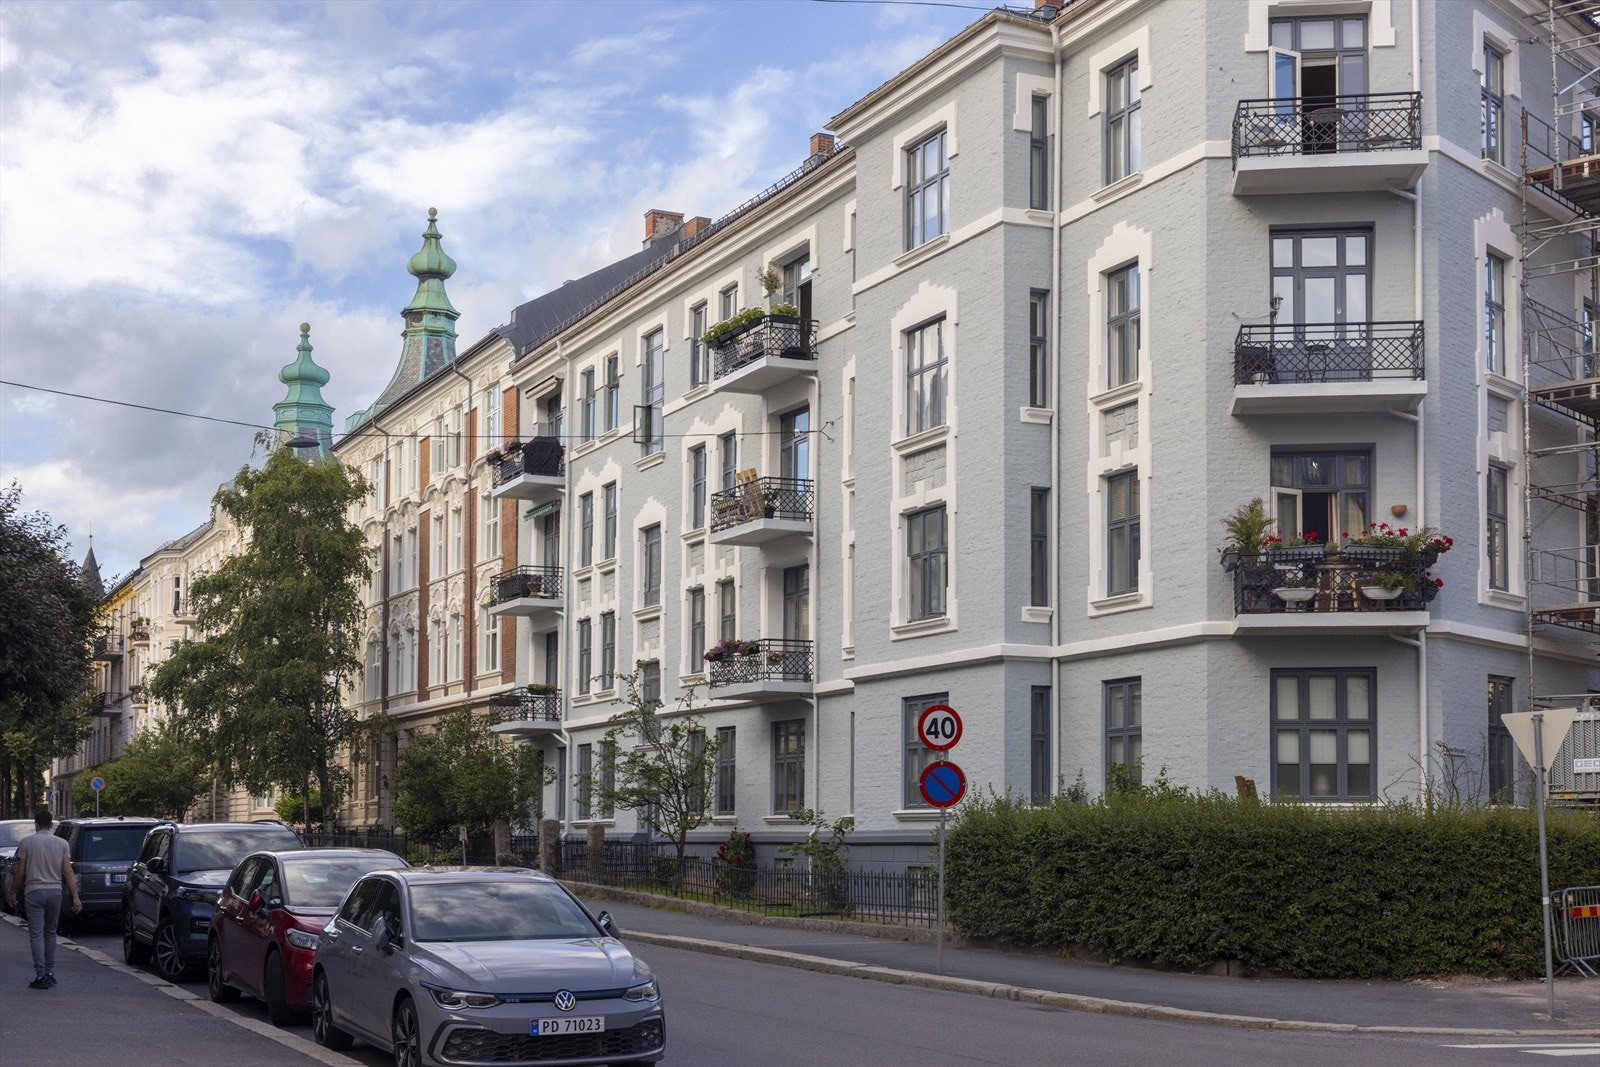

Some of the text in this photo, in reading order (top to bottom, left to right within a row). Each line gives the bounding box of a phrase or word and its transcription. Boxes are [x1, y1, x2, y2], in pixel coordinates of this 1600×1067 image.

[926, 716, 955, 739] 40
[542, 1018, 600, 1032] PD 71023
